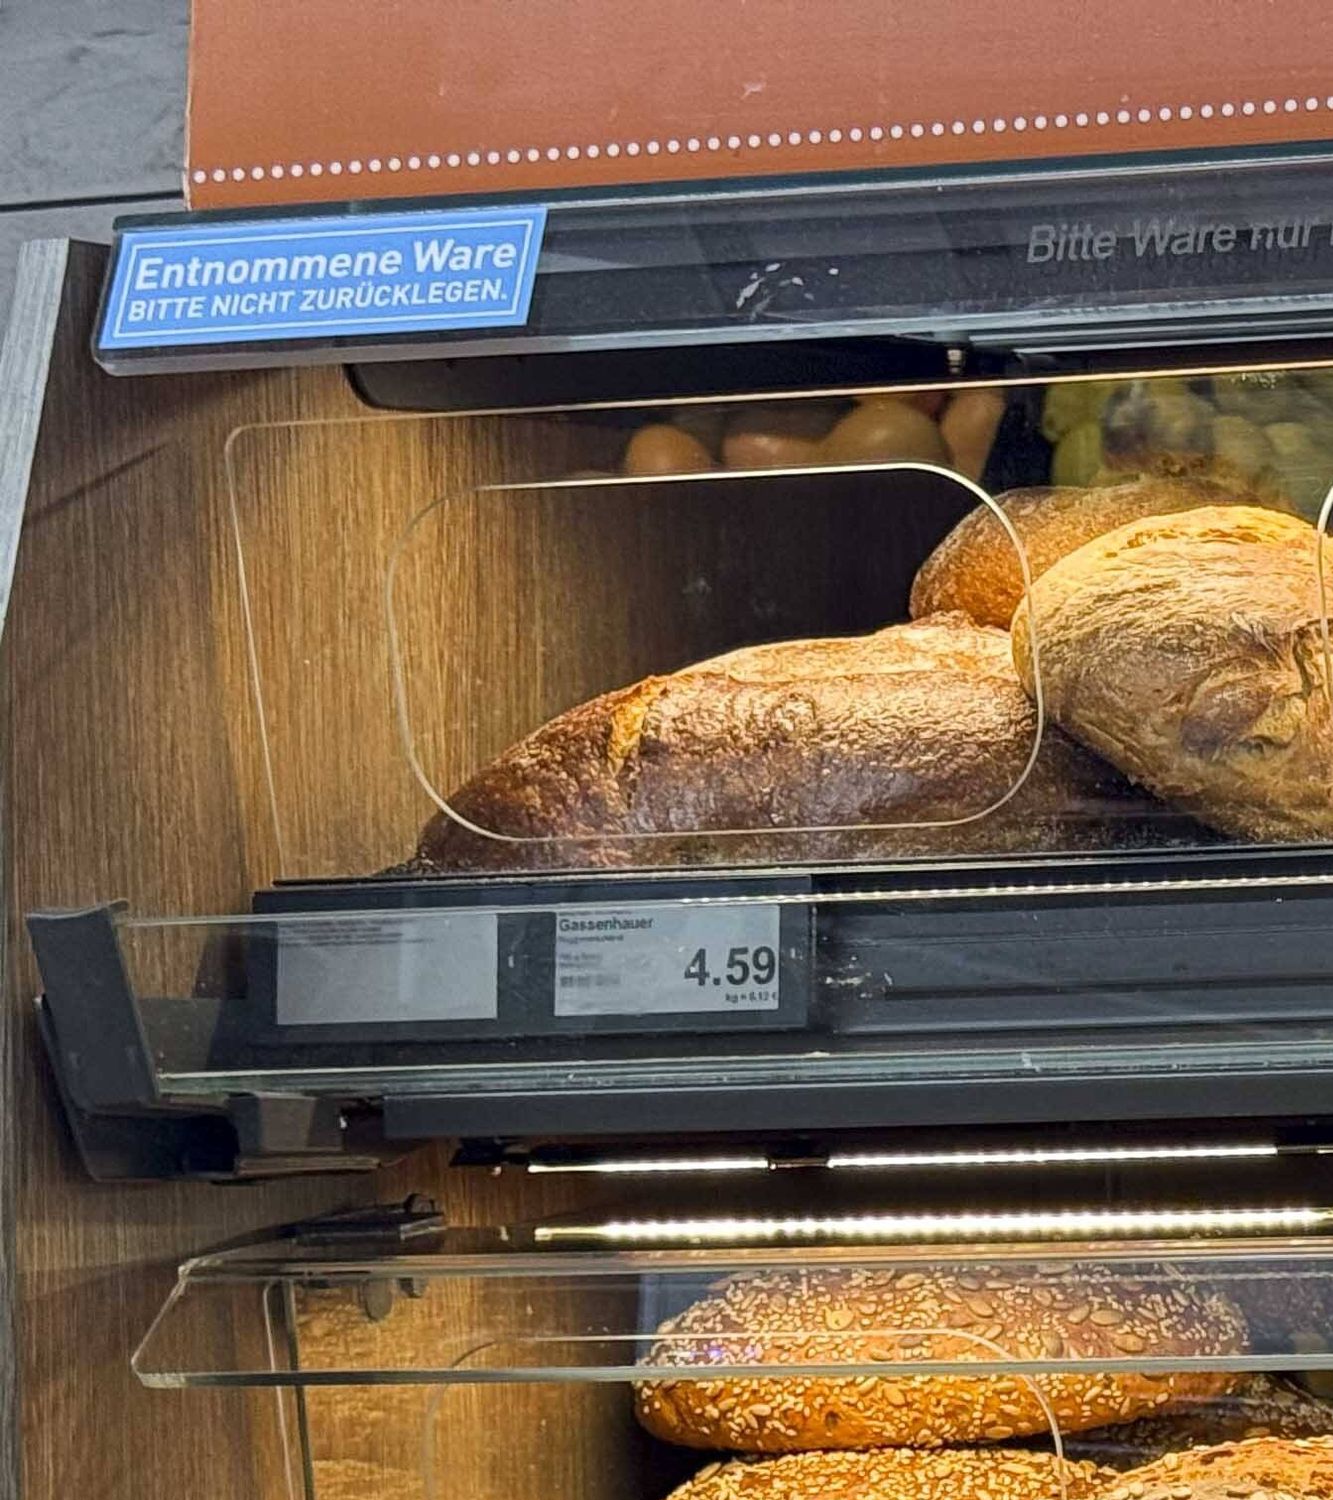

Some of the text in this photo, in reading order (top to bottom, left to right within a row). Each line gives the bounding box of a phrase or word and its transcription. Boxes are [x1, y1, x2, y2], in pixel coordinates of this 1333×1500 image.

[1027, 224, 1118, 263] Bitte
[1132, 218, 1237, 257] Ware
[1249, 217, 1318, 250] nur
[135, 239, 516, 291] Entnommene Ware
[128, 278, 507, 322] BITTE NICHT ZURÜCKLEGEN.
[559, 915, 653, 933] Gassenhauer
[684, 946, 776, 987] 4.59
